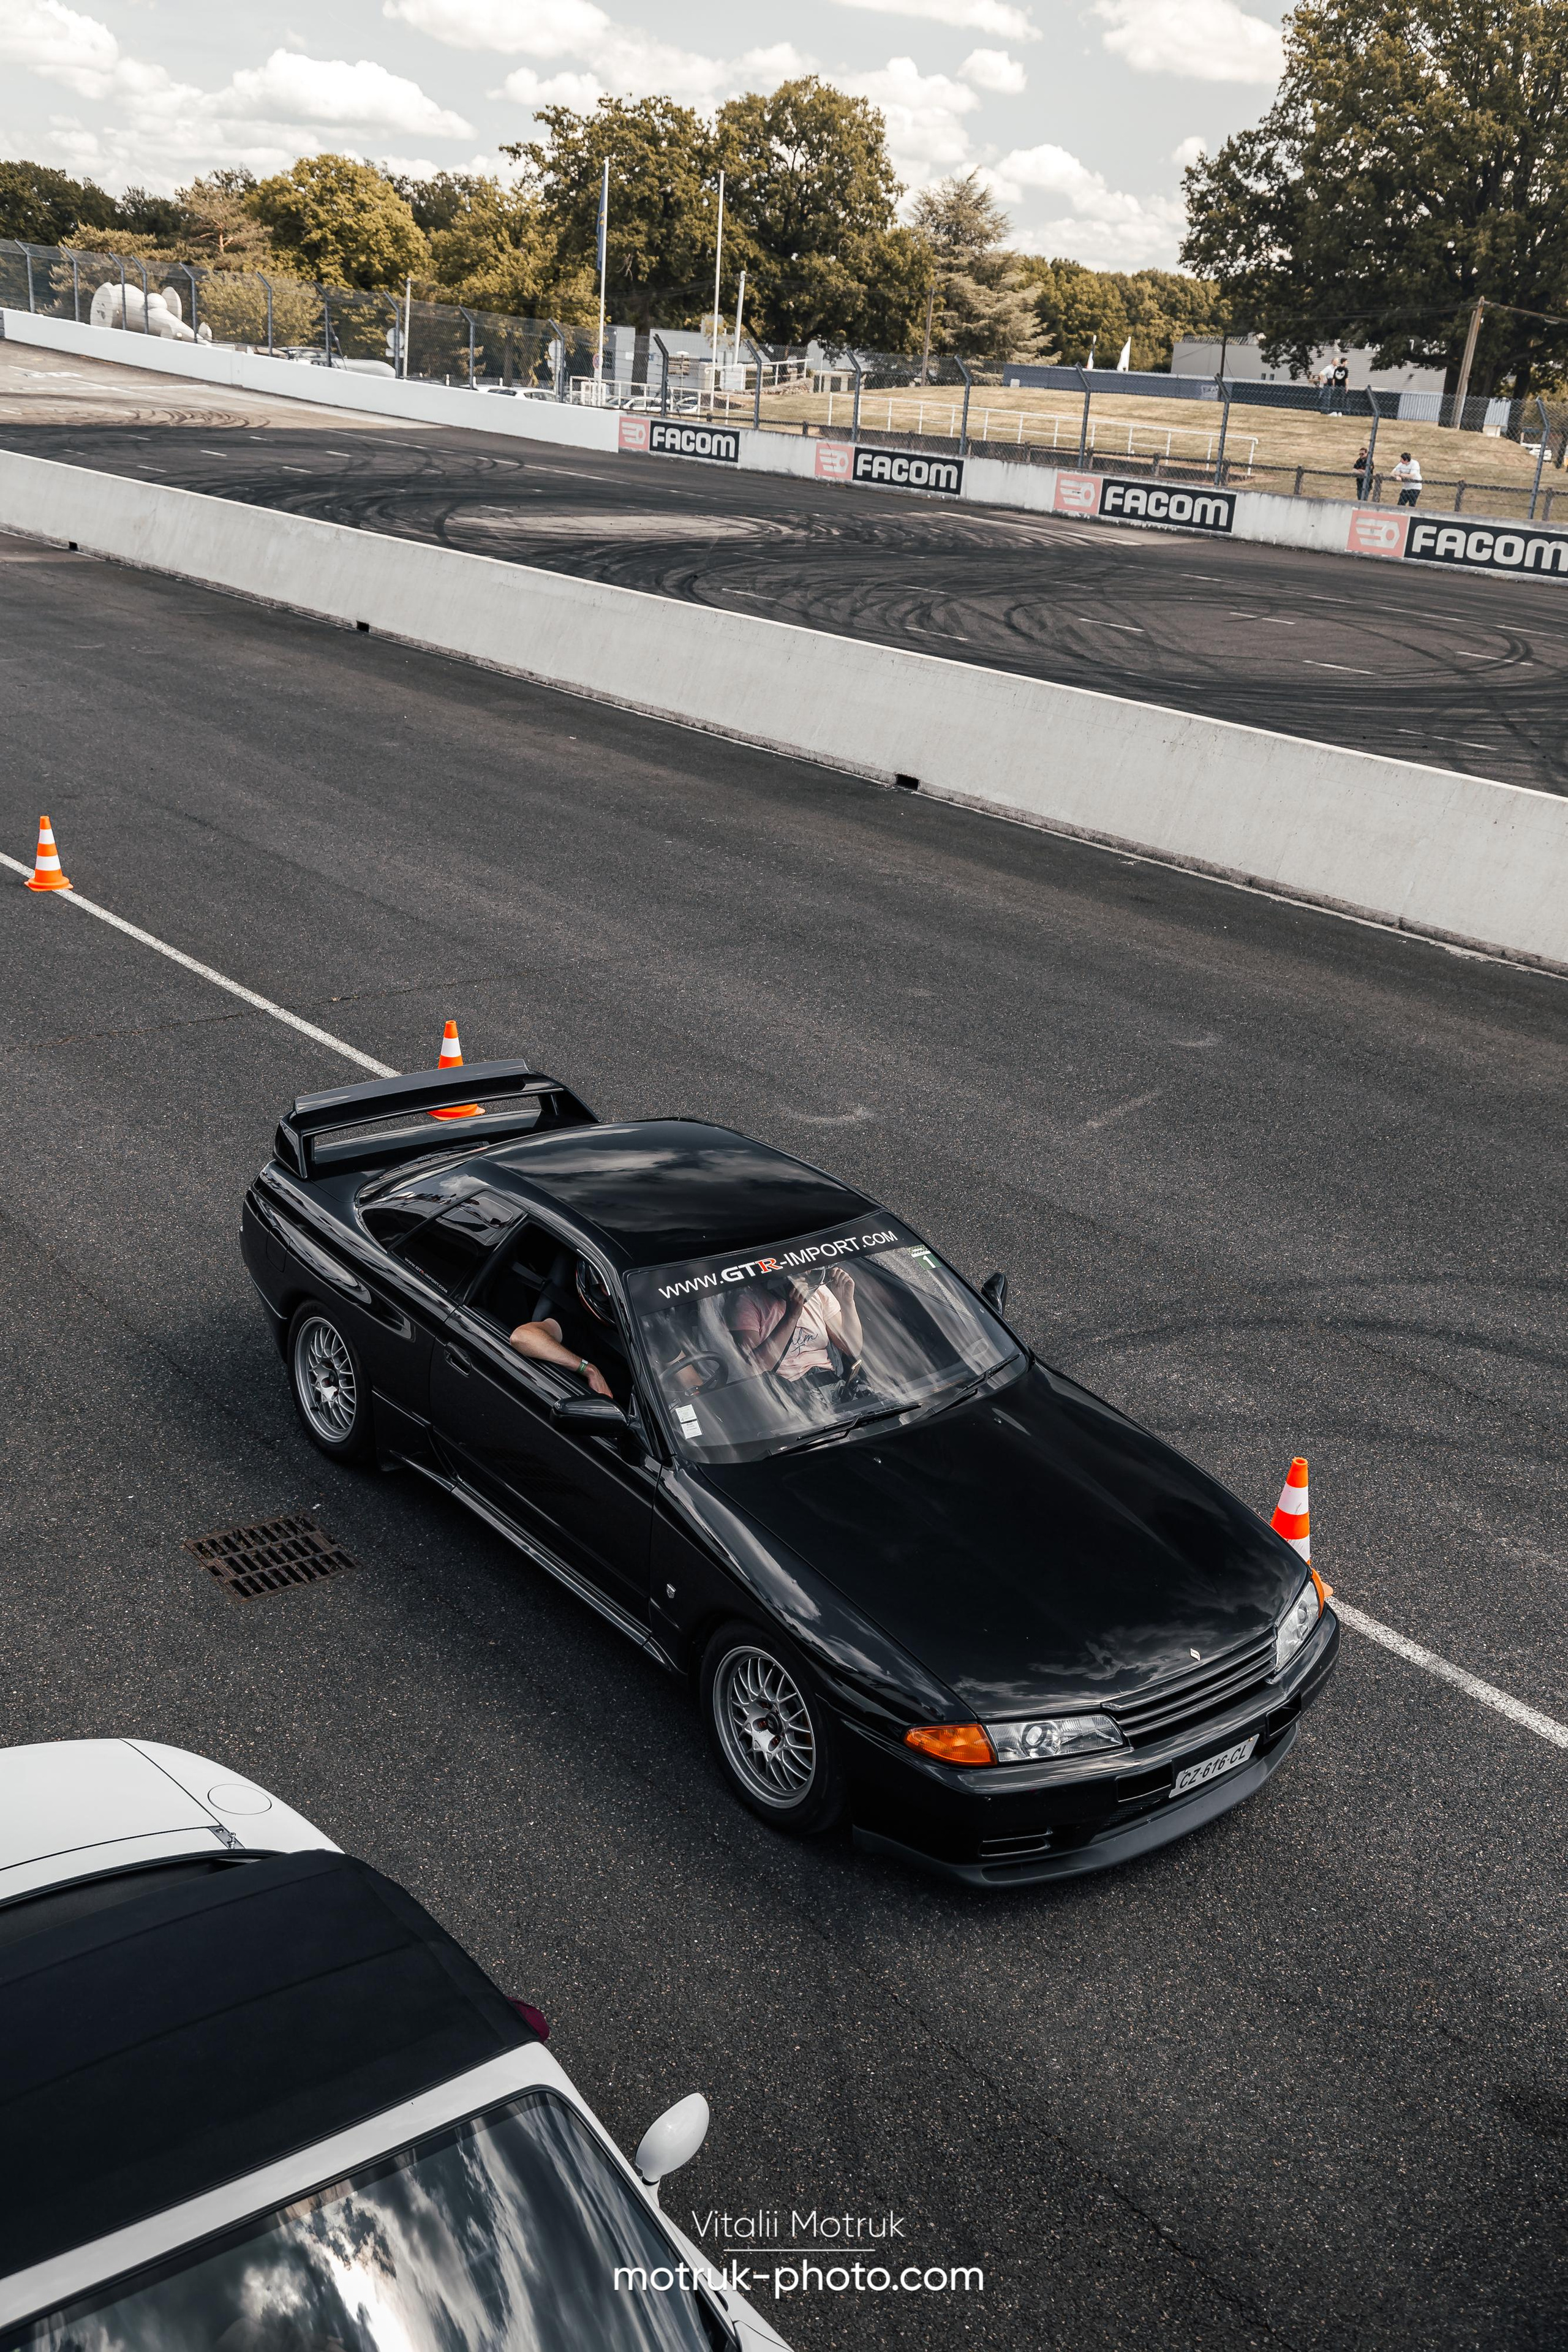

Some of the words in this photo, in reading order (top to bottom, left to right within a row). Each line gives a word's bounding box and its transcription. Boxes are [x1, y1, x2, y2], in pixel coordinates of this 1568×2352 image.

[652, 426, 736, 458] FACOM
[856, 453, 959, 489] FACOM
[1104, 486, 1229, 526] FACOM
[1411, 525, 1568, 571] FACOM
[658, 1230, 899, 1299] WWW.GTR-IMPORT.COM
[922, 1255, 937, 1268] 1
[1180, 1744, 1247, 1789] CZ-616-CL
